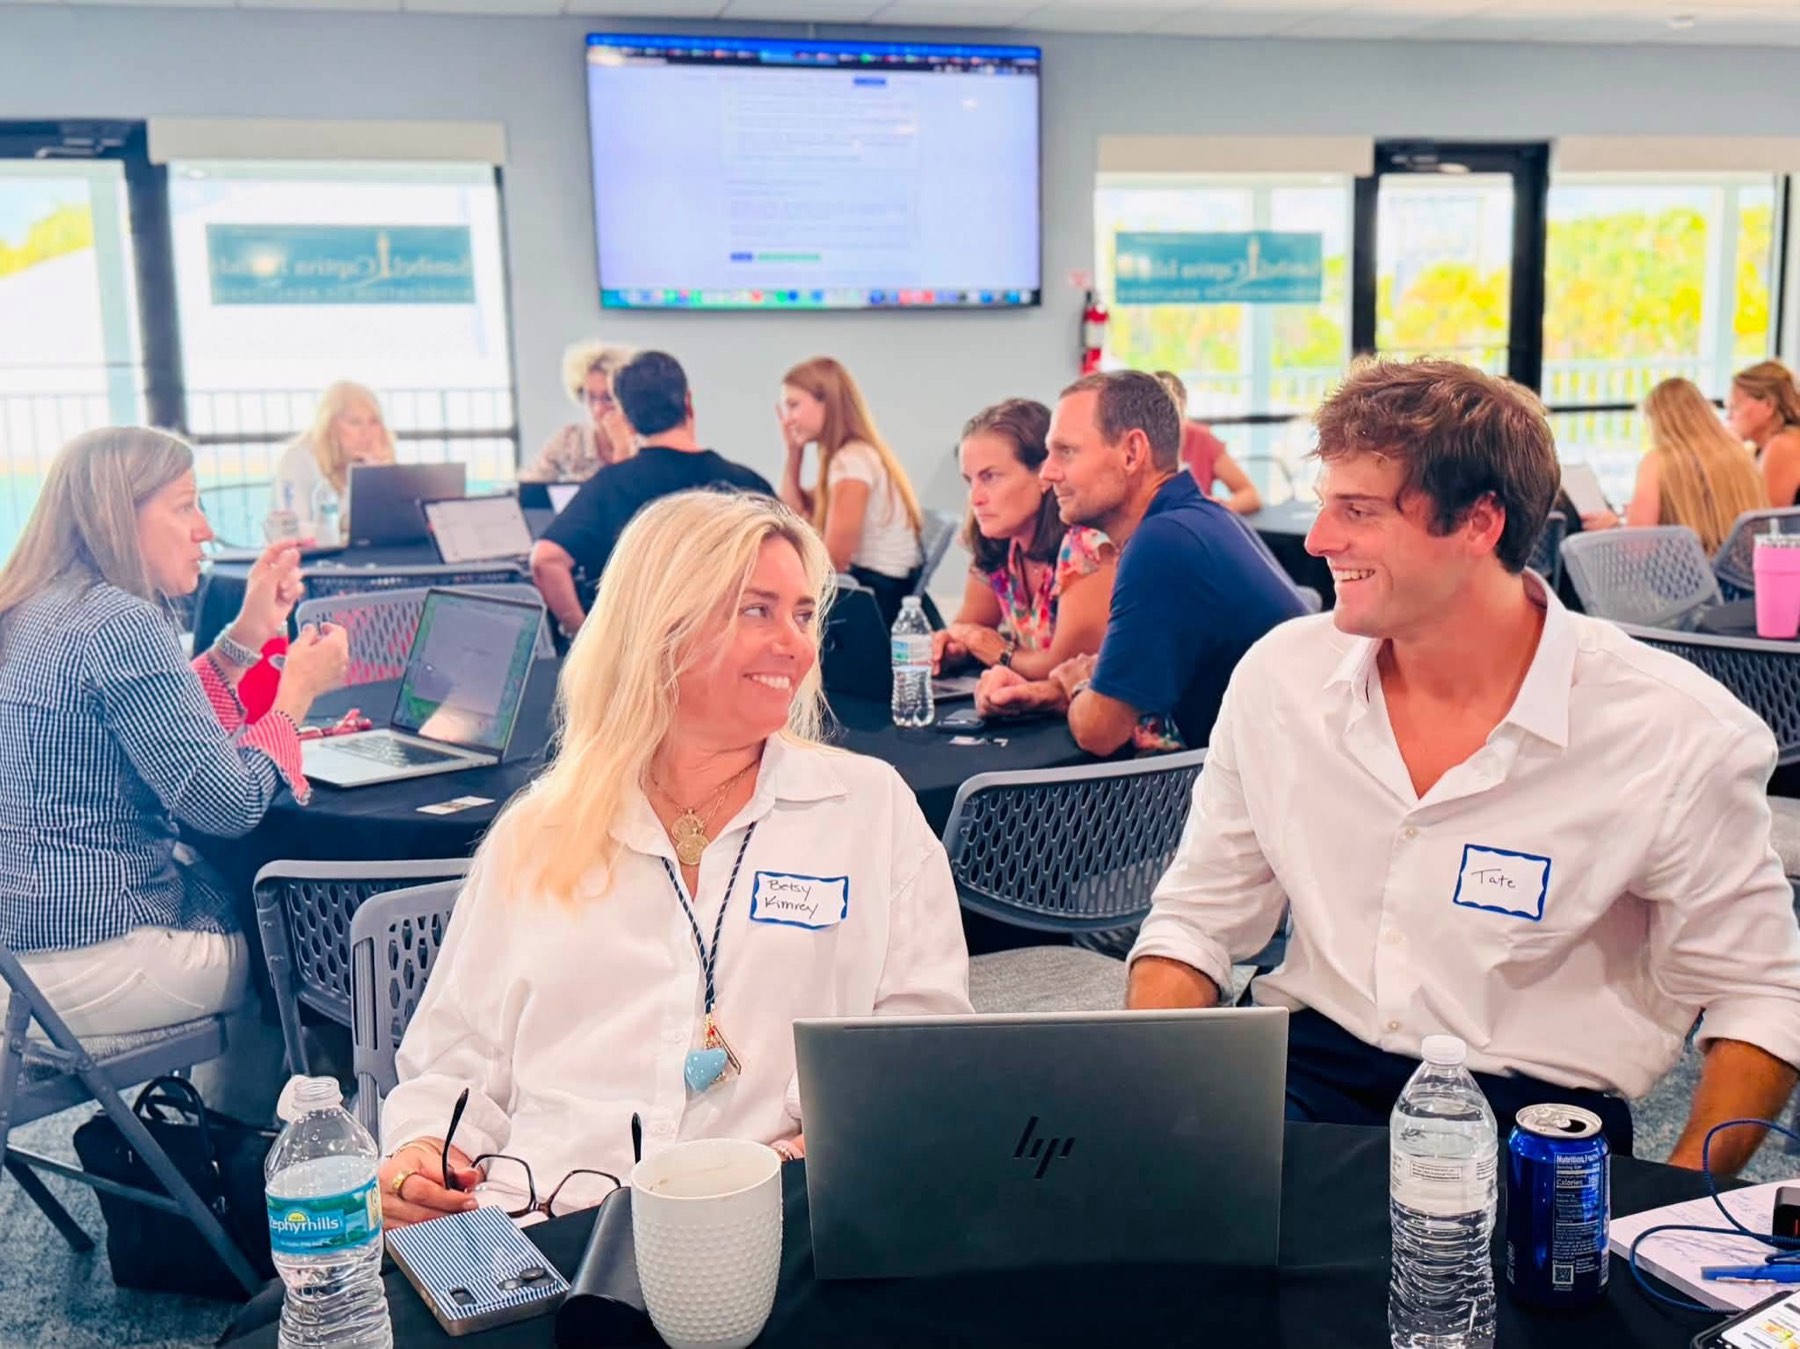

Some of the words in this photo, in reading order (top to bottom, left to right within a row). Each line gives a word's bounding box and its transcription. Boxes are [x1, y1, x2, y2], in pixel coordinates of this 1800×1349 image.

[1470, 868, 1516, 889] Tate
[768, 880, 811, 901] Betsy
[765, 896, 818, 919] Kimrey
[1012, 1116, 1076, 1179] hp
